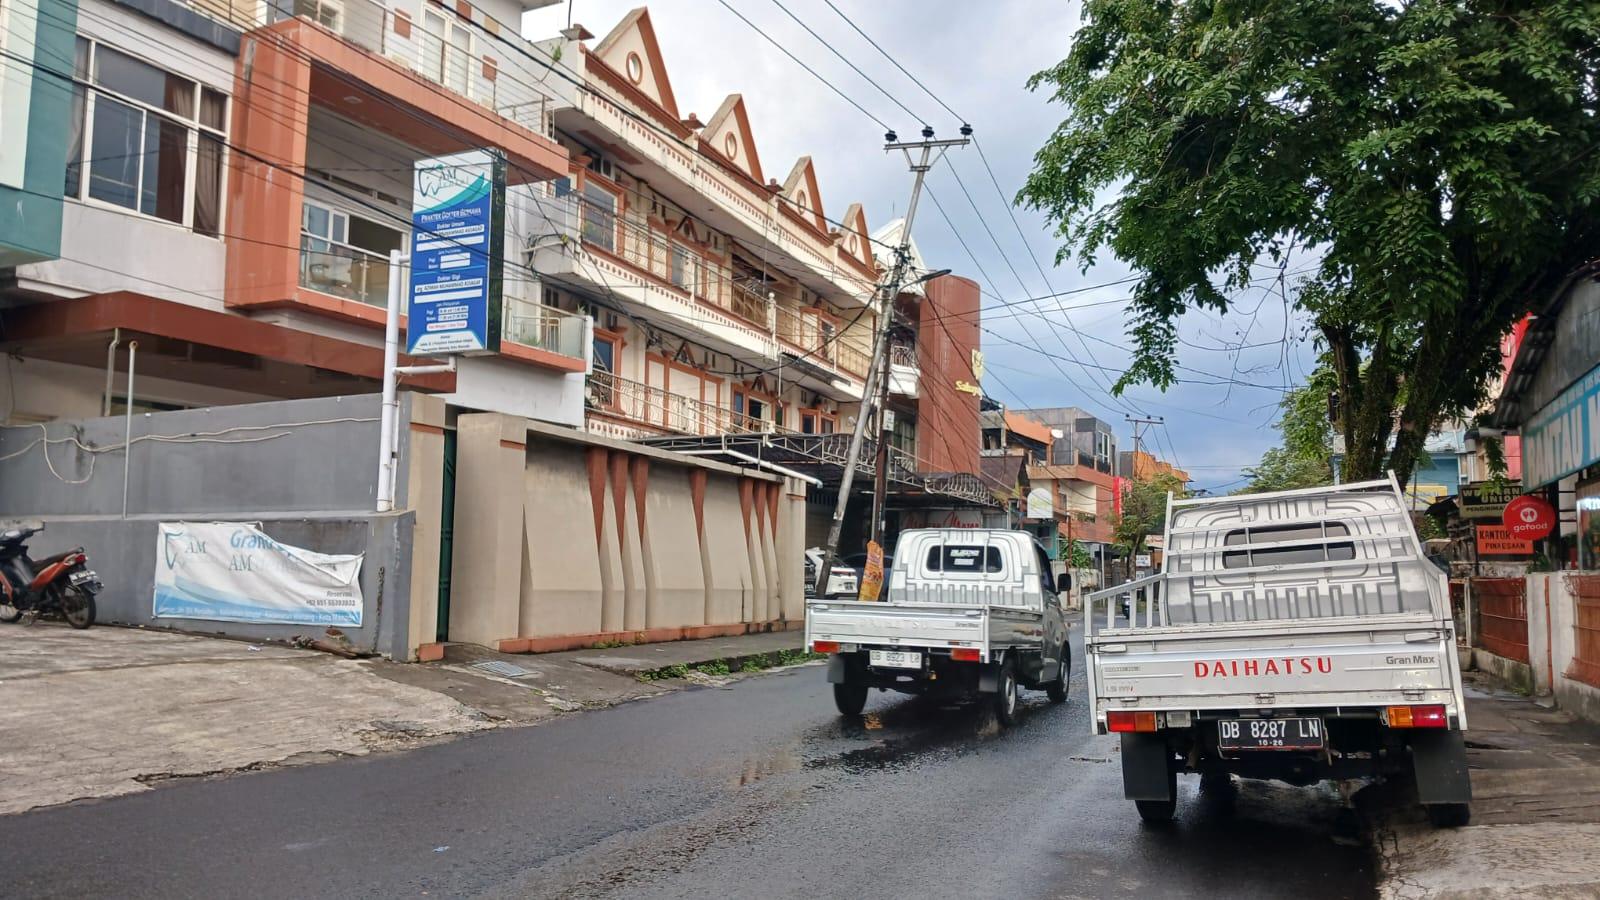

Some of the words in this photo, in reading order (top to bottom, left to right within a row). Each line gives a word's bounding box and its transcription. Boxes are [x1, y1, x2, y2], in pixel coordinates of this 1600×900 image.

[1527, 402, 1583, 489] RANTAU
[1479, 530, 1511, 540] KANTOR
[1513, 523, 1548, 532] gofood
[185, 540, 207, 554] AM
[228, 554, 253, 571] AM
[1194, 656, 1332, 678] DAIHATSU
[1386, 655, 1411, 665] Gran
[1413, 655, 1435, 664] Max
[1222, 721, 1240, 738] DB
[1250, 720, 1286, 738] 8287
[1299, 720, 1319, 738] LN
